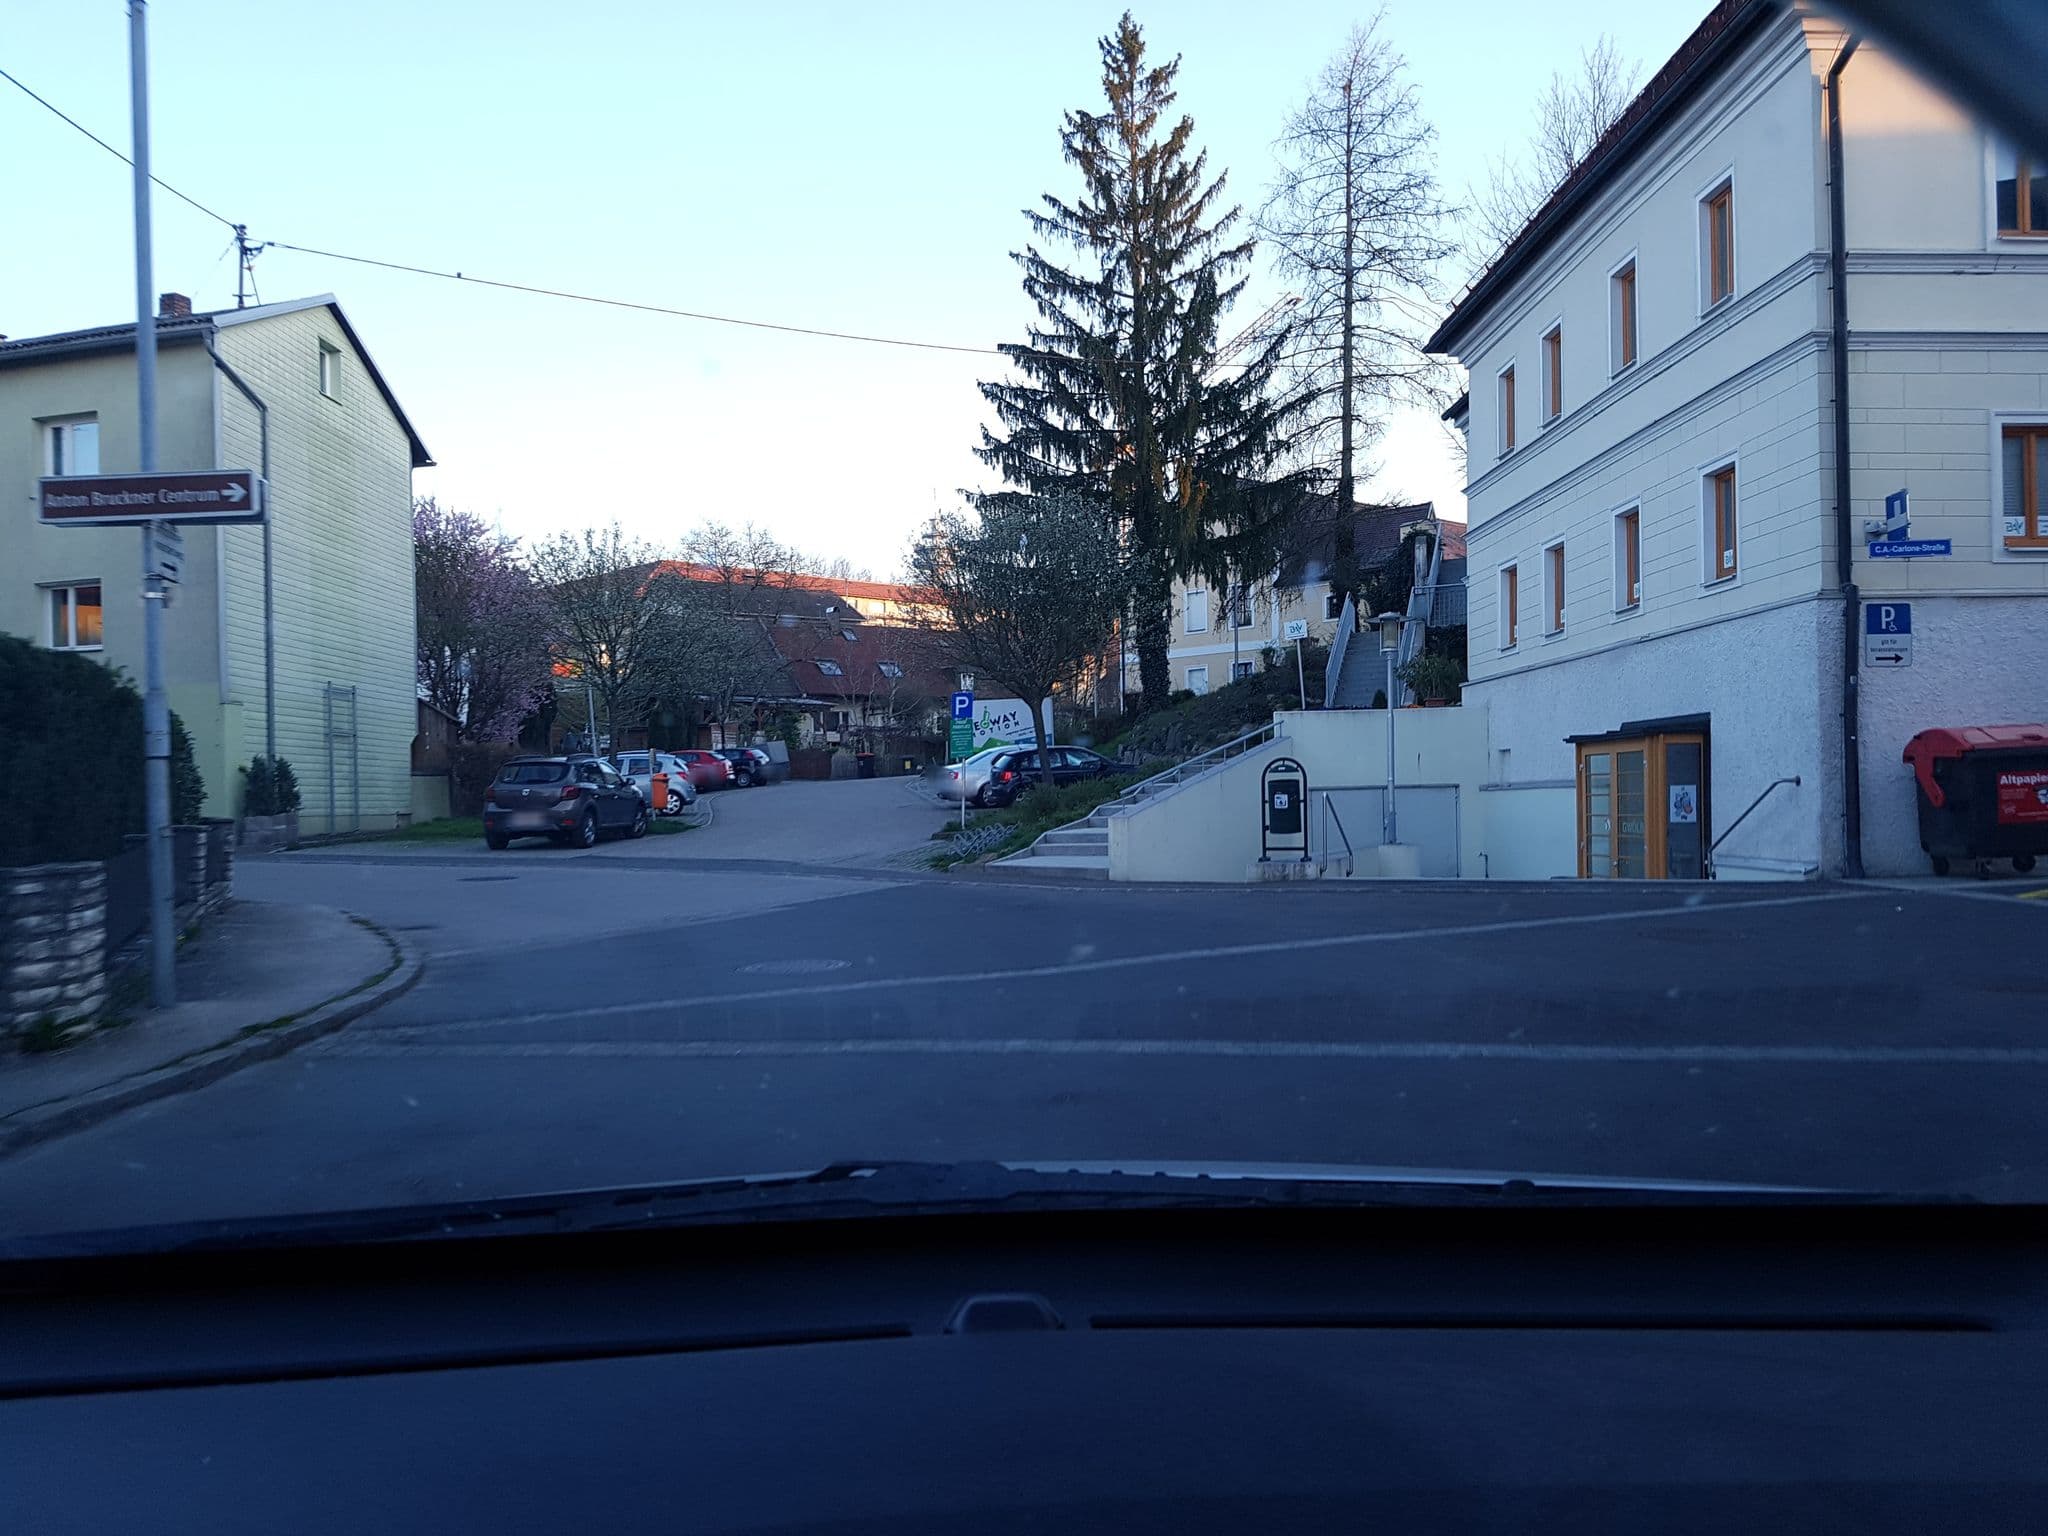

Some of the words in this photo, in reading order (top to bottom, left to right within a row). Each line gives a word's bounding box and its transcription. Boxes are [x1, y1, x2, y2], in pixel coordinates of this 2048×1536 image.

[158, 488, 220, 504] Centrum
[1881, 606, 1896, 630] P
[955, 696, 969, 715] P
[973, 720, 1020, 738] OTION
[2000, 773, 2048, 786] Altpapie
